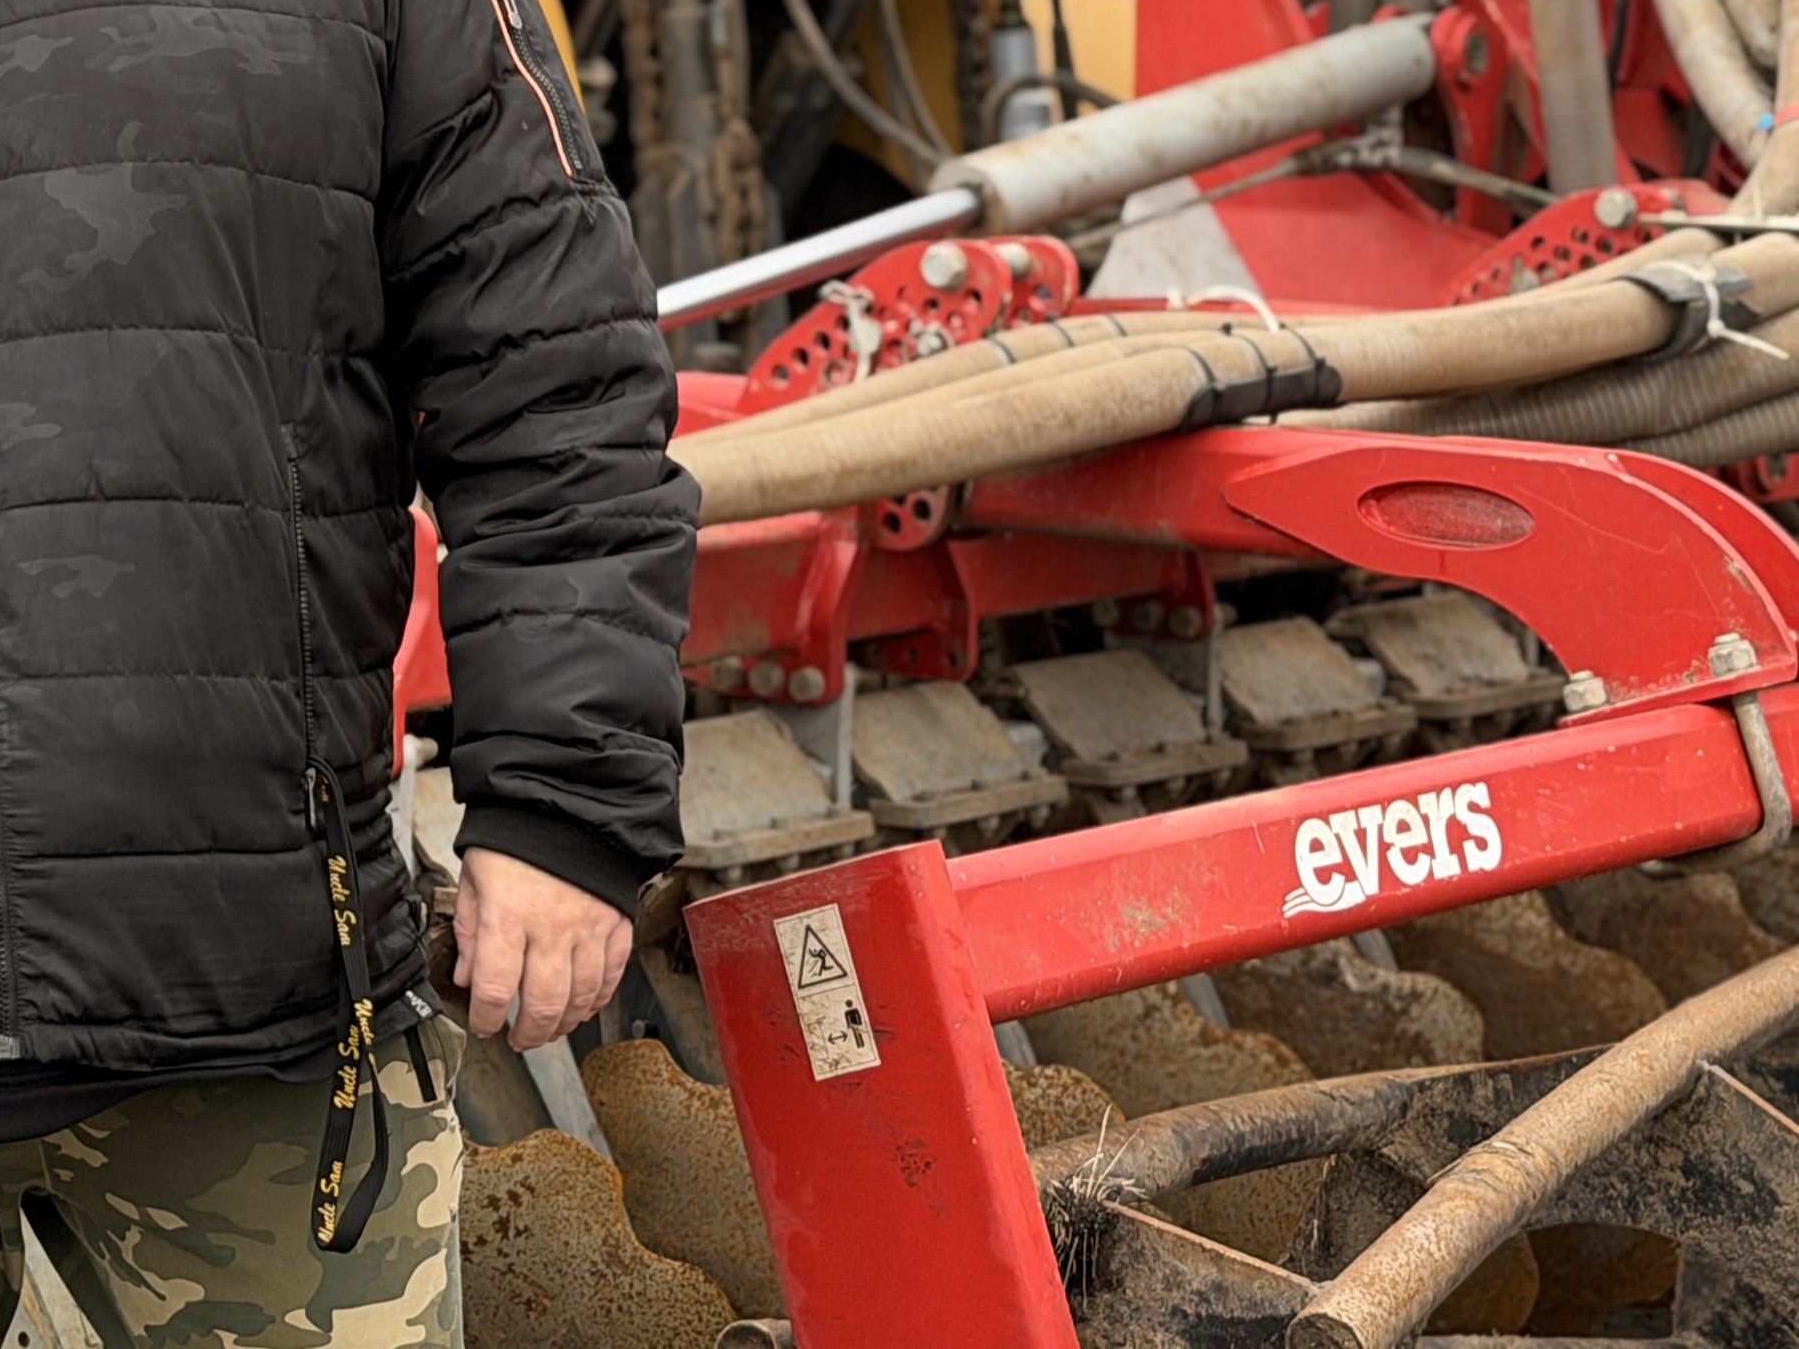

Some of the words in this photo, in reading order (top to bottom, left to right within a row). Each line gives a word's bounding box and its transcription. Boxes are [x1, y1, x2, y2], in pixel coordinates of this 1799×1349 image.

[1282, 781, 1501, 918] evers
[327, 855, 351, 902] Uncle
[334, 909, 357, 946] Sam
[338, 1024, 360, 1060] Sam
[333, 1065, 357, 1109] Uncle
[320, 1160, 343, 1198] Sam
